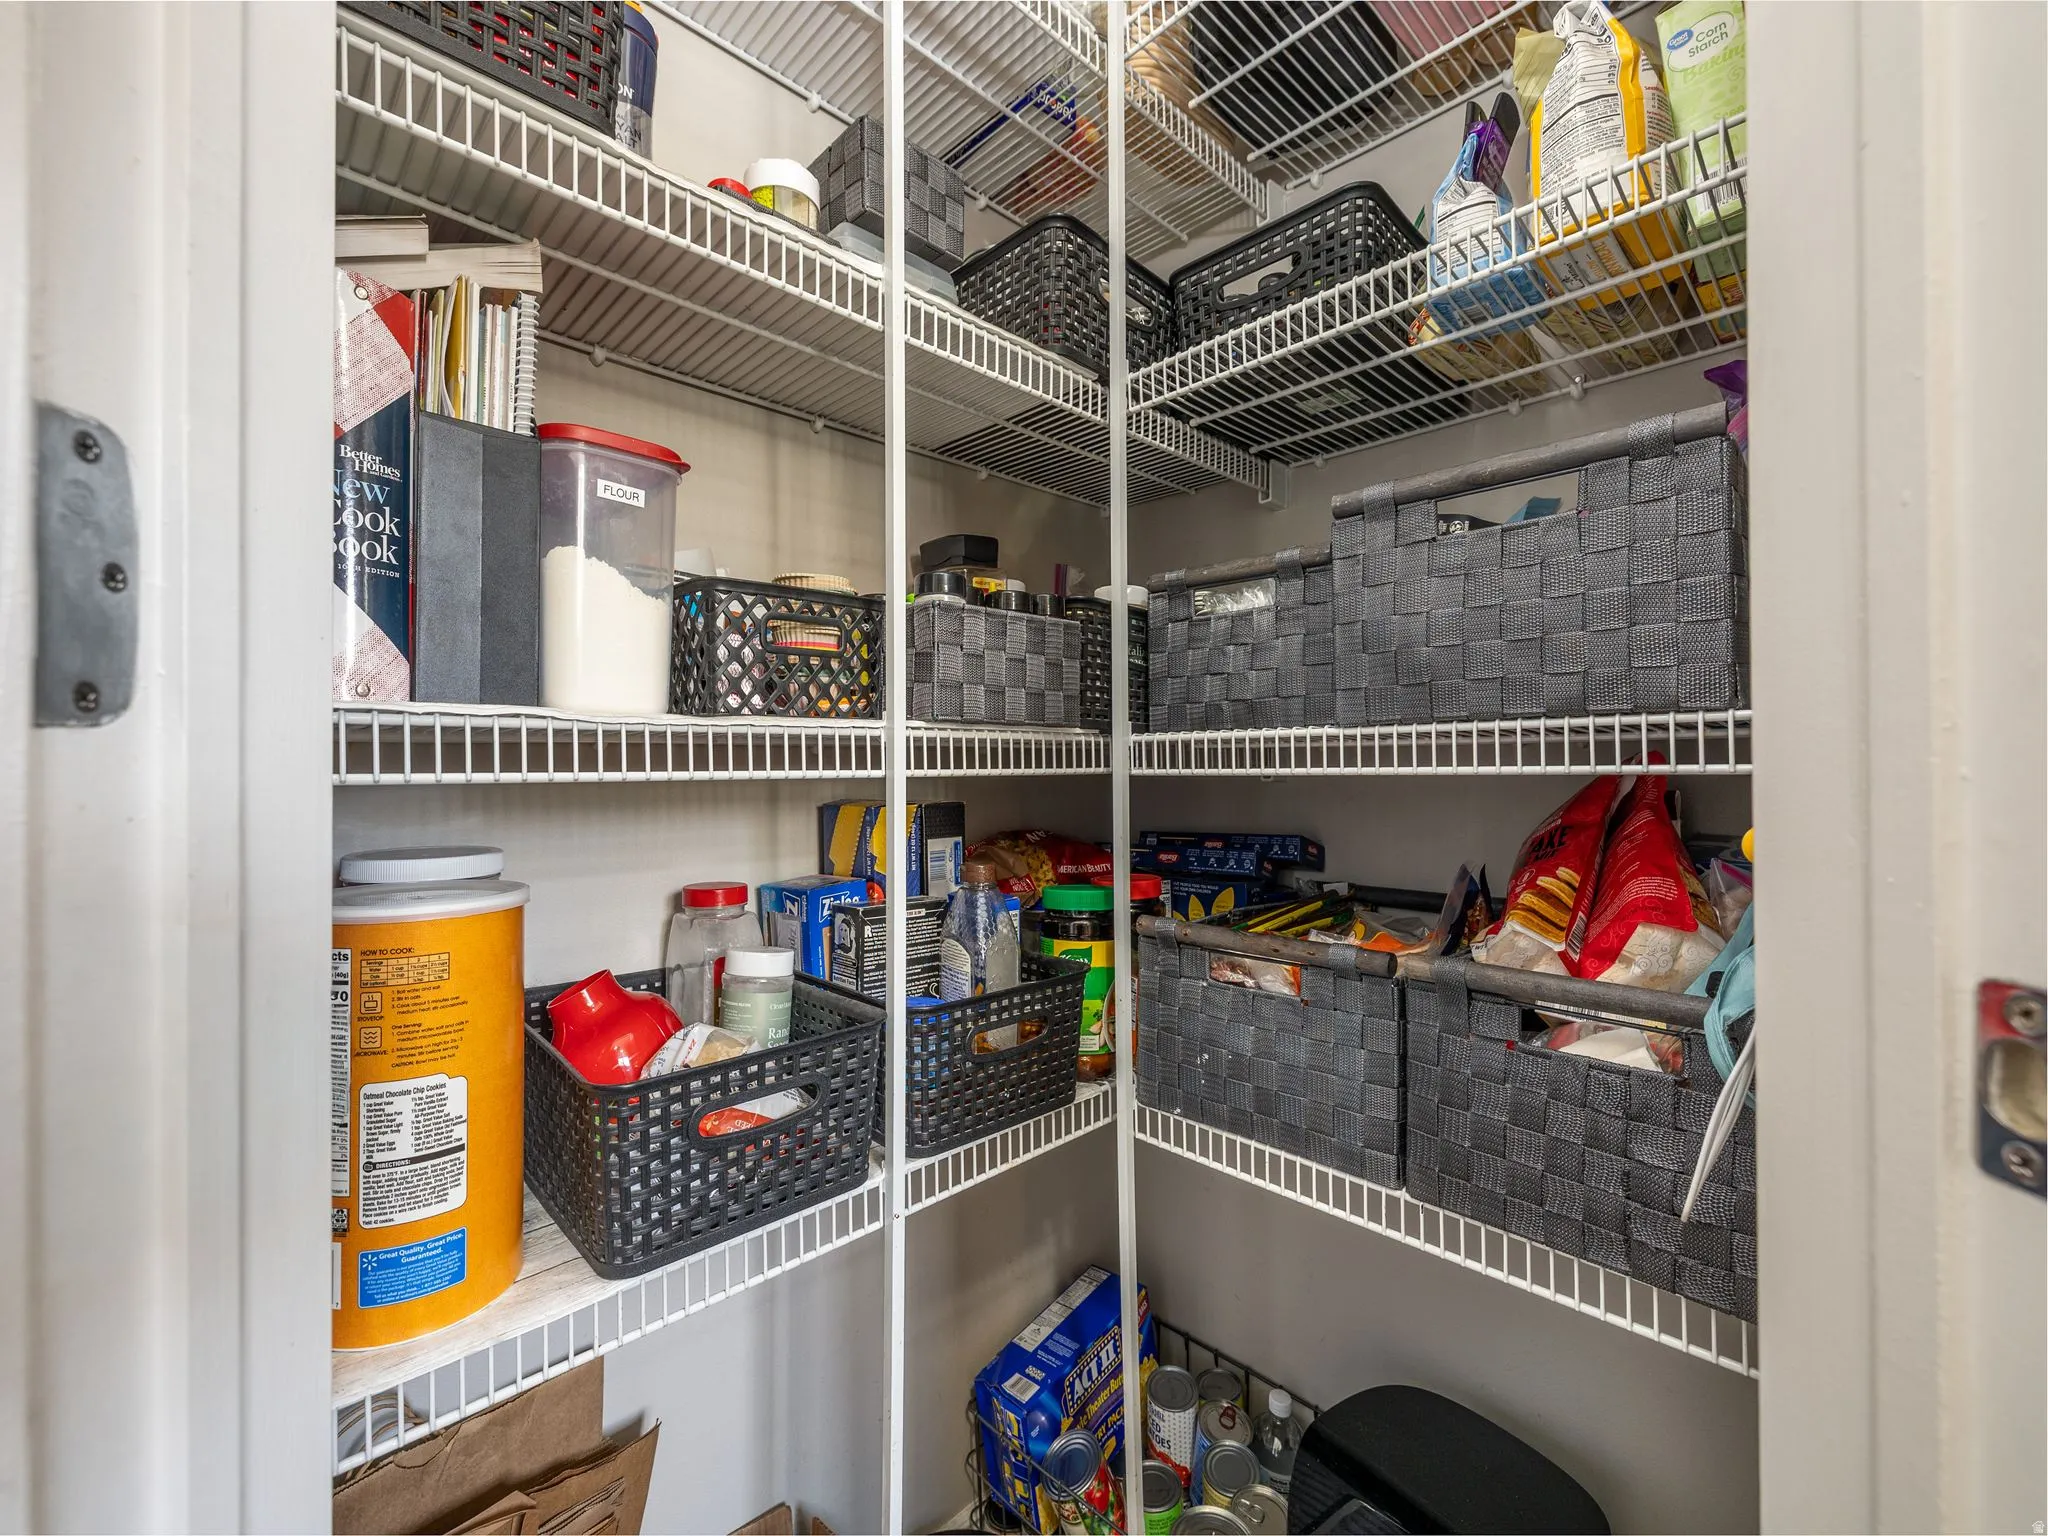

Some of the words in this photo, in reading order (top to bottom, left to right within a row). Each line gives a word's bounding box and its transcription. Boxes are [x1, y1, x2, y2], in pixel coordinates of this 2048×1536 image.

[1695, 22, 1727, 42] Corn
[1689, 31, 1728, 58] Starch
[340, 444, 382, 464] Better
[355, 459, 400, 477] Homes
[604, 484, 639, 502] FLOUR
[332, 530, 399, 565] ook
[365, 566, 400, 578] EDITION
[911, 853, 915, 864] WT
[1086, 864, 1111, 873] BEAUTY
[363, 1092, 384, 1100] Oatmeal
[385, 1089, 412, 1098] Chocolate
[413, 1086, 425, 1094] Chip
[426, 1082, 446, 1091] Cookies
[379, 1251, 398, 1260] Great
[399, 1246, 426, 1256] Quality.
[427, 1239, 446, 1249] Great
[446, 1233, 463, 1242] Price.
[401, 1247, 443, 1263] Guaranteed.
[1074, 1355, 1098, 1402] ACT
[1099, 1339, 1116, 1371] II
[1086, 1388, 1110, 1419] Theater
